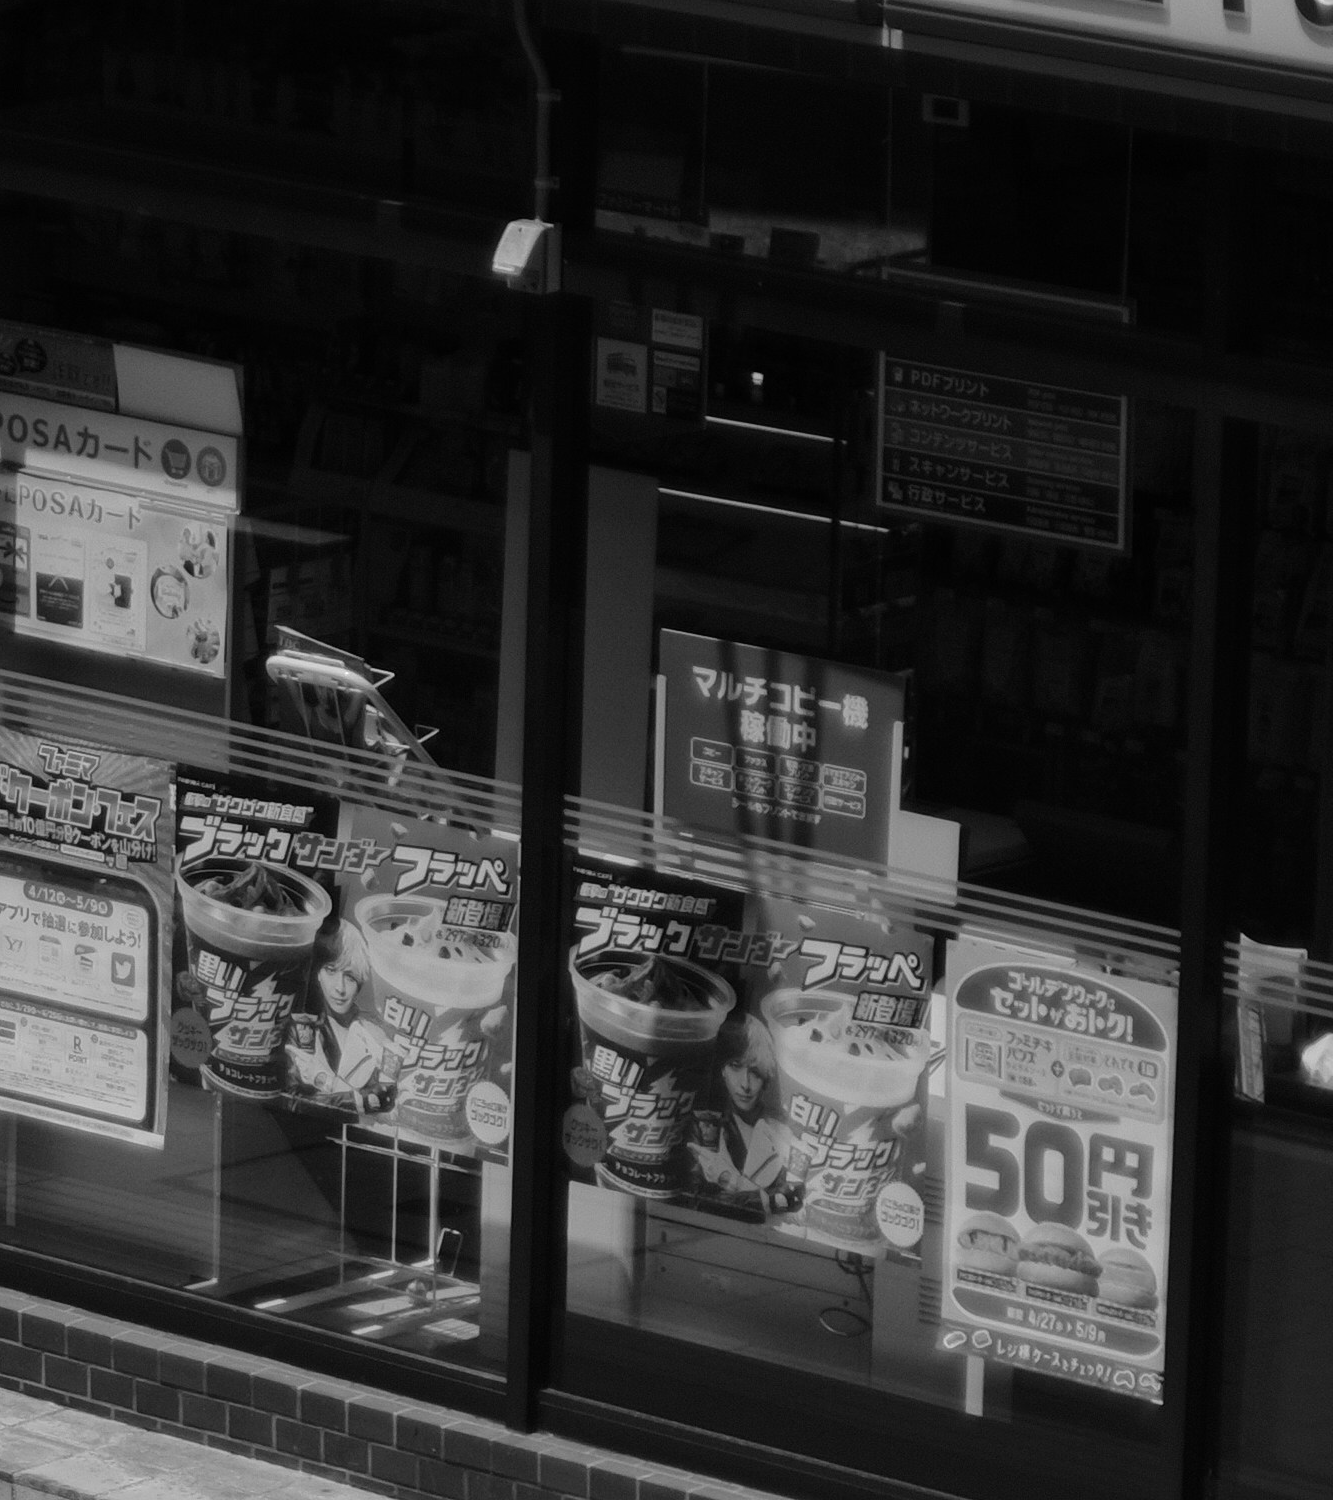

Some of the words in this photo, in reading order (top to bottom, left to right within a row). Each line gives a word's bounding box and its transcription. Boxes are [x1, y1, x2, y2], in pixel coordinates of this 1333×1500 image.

[911, 369, 990, 397] PDFプリント
[908, 400, 1012, 431] ネットワークプリント
[909, 455, 1010, 489] スキャンサービス
[692, 665, 869, 730] マルチコピー機
[37, 743, 101, 782] ファミマ
[390, 843, 515, 897] フラッペ
[197, 949, 248, 992] 黒い
[799, 937, 928, 992] フラッペ
[383, 996, 432, 1039] 白い
[989, 985, 1134, 1043] セットがおトク!
[591, 1044, 645, 1091] 黒い
[789, 1093, 840, 1138] 白い
[965, 1101, 1084, 1232] 50
